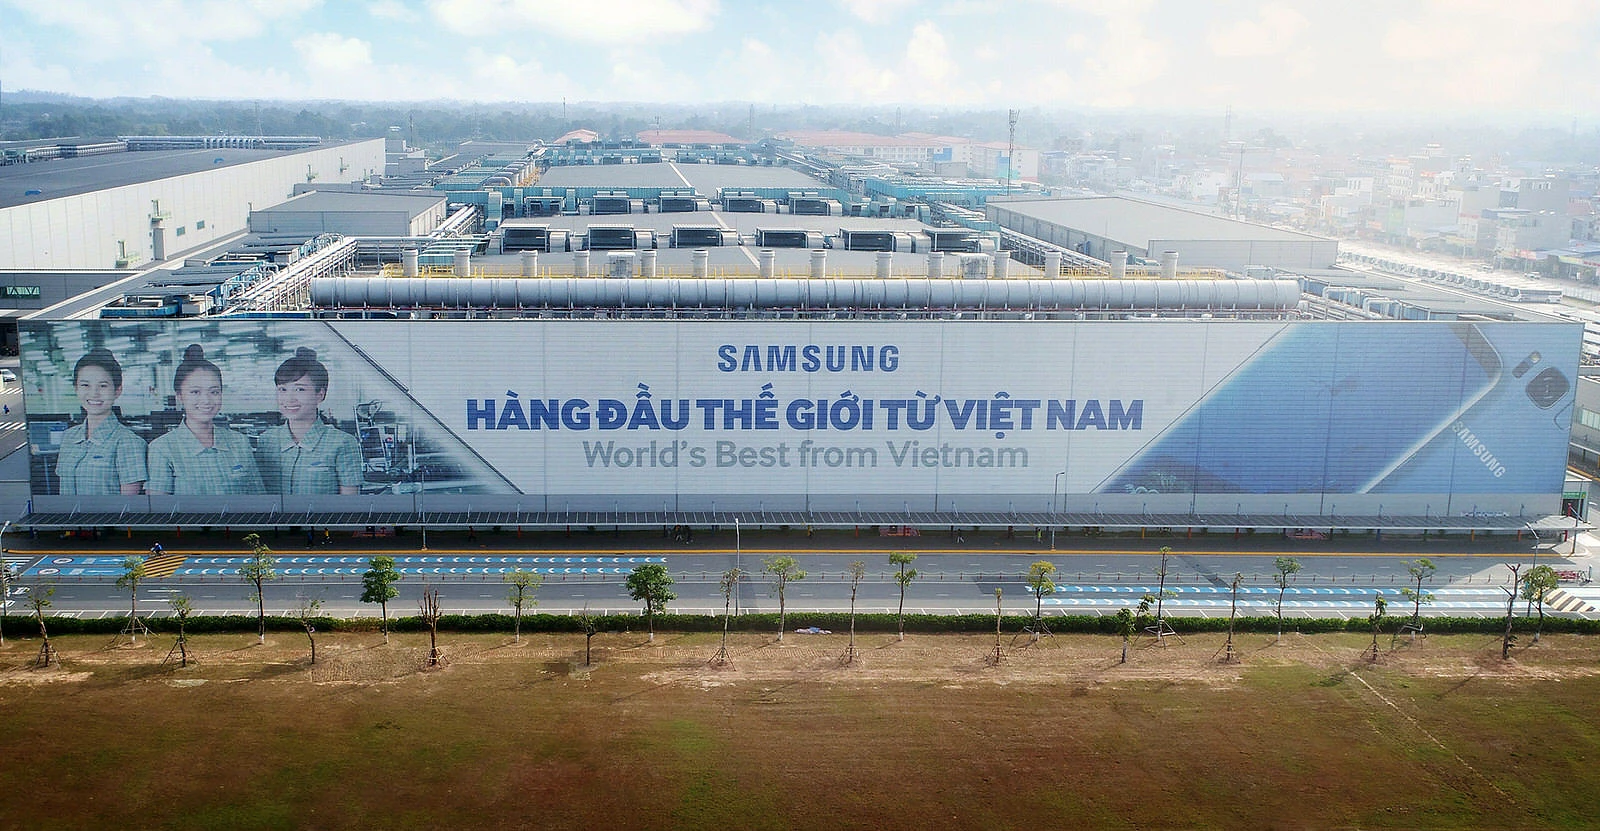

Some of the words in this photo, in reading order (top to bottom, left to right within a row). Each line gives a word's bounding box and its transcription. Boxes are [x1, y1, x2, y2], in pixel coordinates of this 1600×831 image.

[717, 344, 900, 373] SAMSUNG
[466, 389, 592, 431] HÀNG
[595, 382, 691, 431] ĐẦU
[696, 382, 780, 431] THẾ
[785, 389, 874, 431] GIỚI
[880, 389, 942, 431] TỪ
[944, 391, 1042, 440] VIỆT
[1046, 399, 1144, 431] NAM
[715, 440, 791, 468] Best
[798, 440, 878, 468] from
[885, 440, 1029, 468] Vietnam
[1453, 420, 1505, 478] SAMSUNG
